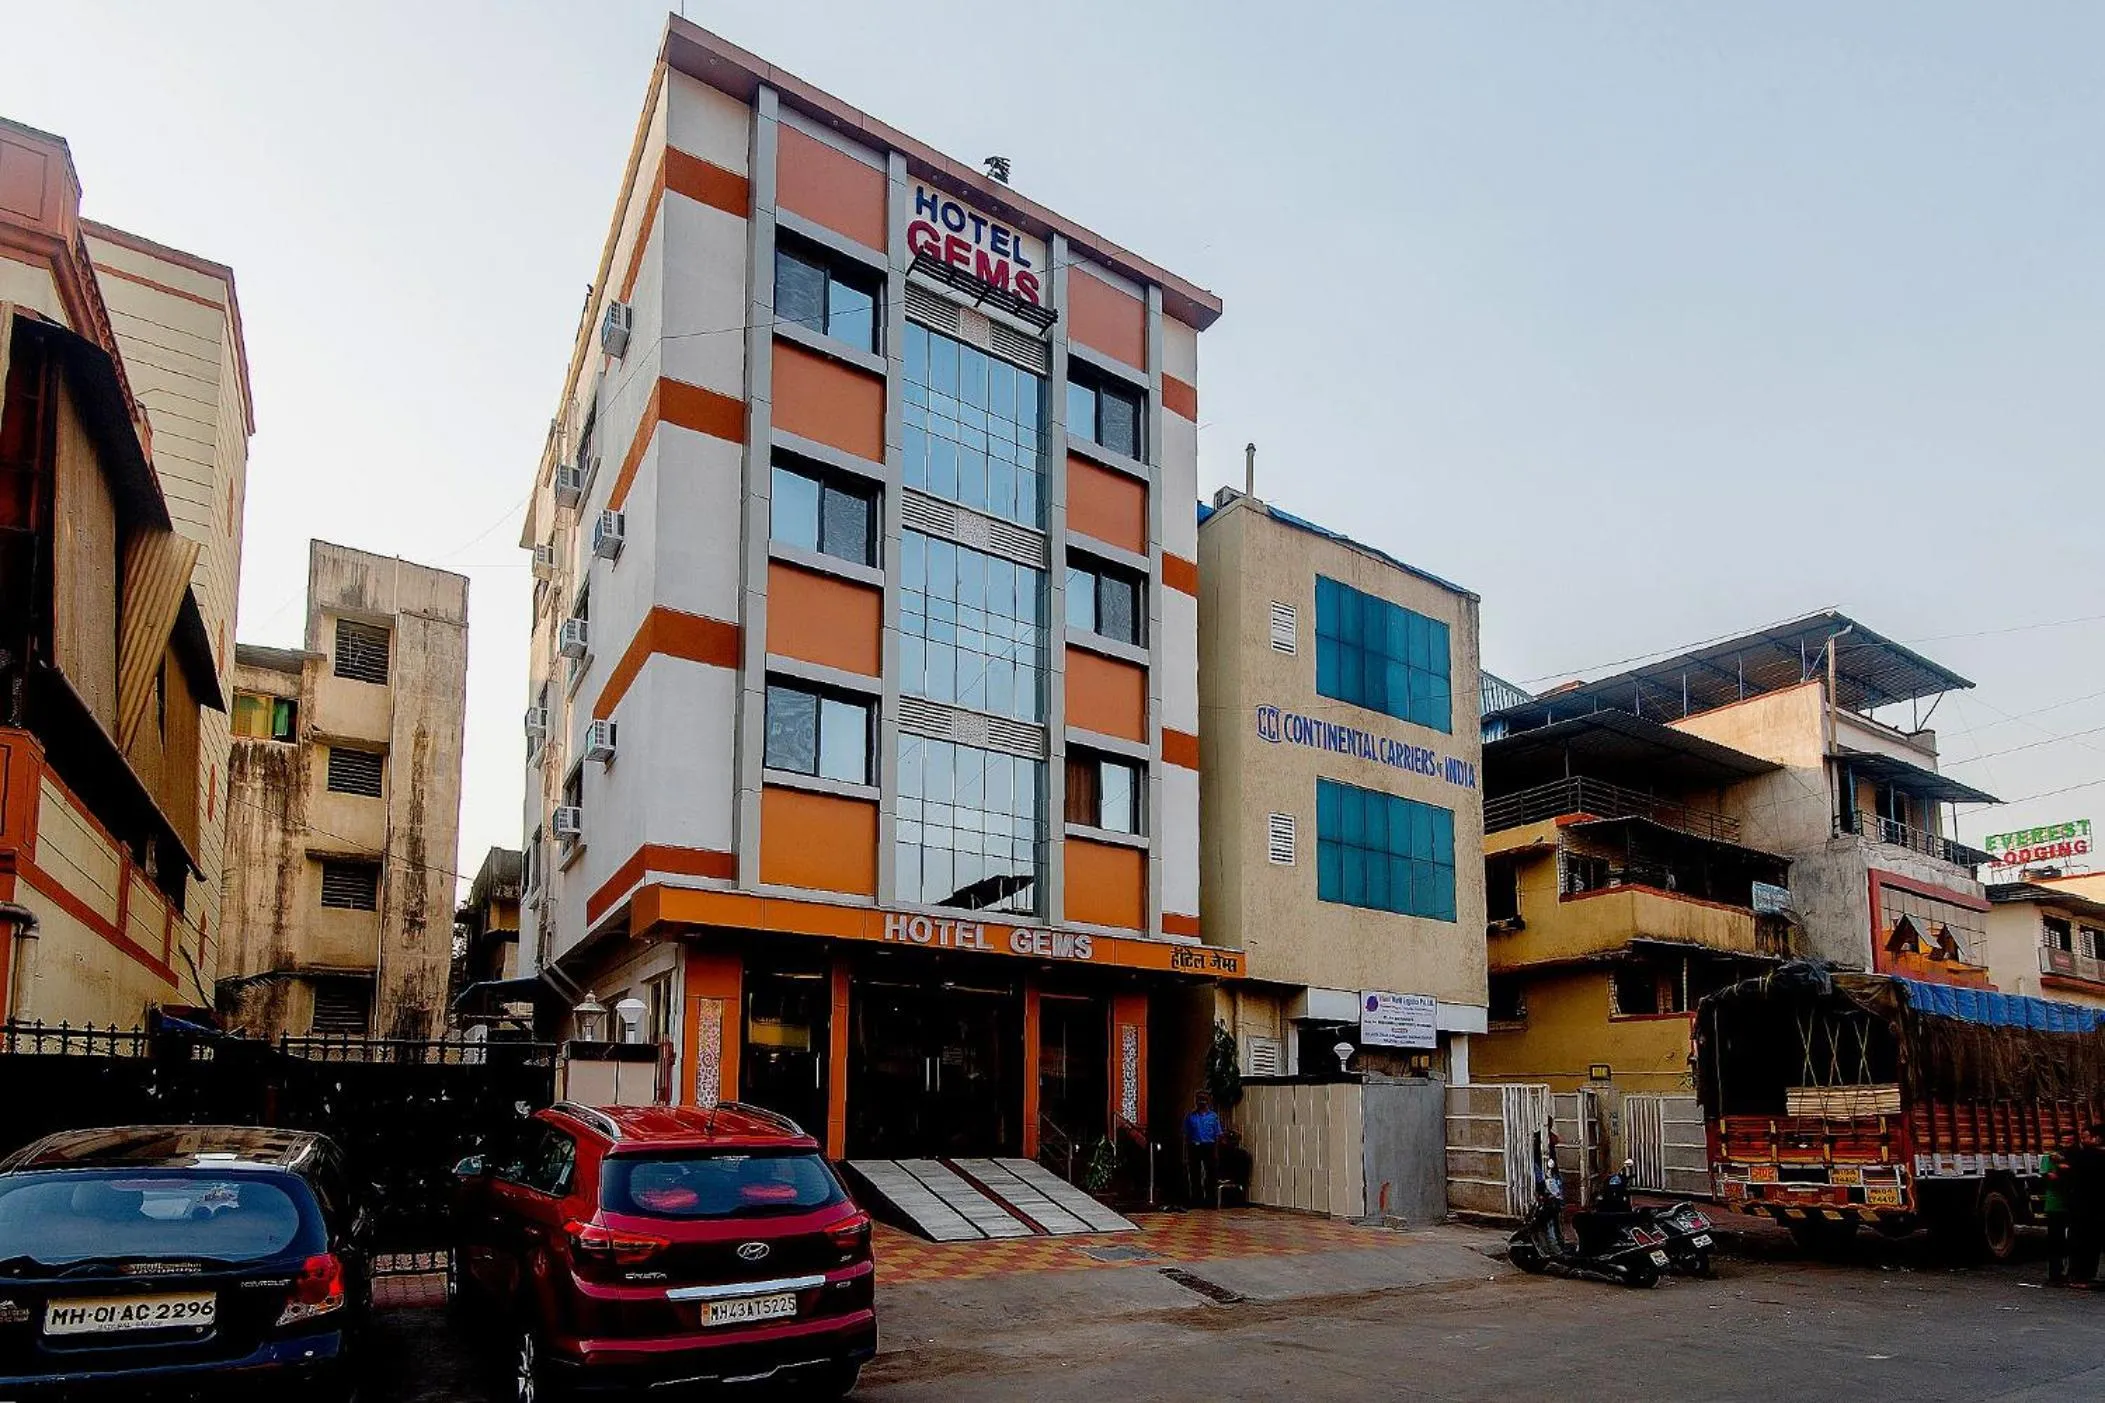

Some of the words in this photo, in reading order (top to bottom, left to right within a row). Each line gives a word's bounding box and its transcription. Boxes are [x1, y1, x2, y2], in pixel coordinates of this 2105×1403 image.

[916, 185, 1032, 268] HOTEL
[906, 219, 1040, 306] GEMS
[1284, 713, 1379, 762] CONTINENTAL
[1380, 736, 1436, 777] CARRIERS
[1445, 755, 1476, 789] INDIA
[1985, 819, 2089, 851] EVEREST
[1987, 839, 2089, 868] ODGING
[884, 913, 994, 951] HOTEL
[1009, 927, 1094, 960] GEMS
[710, 1297, 796, 1322] MH43AT5225
